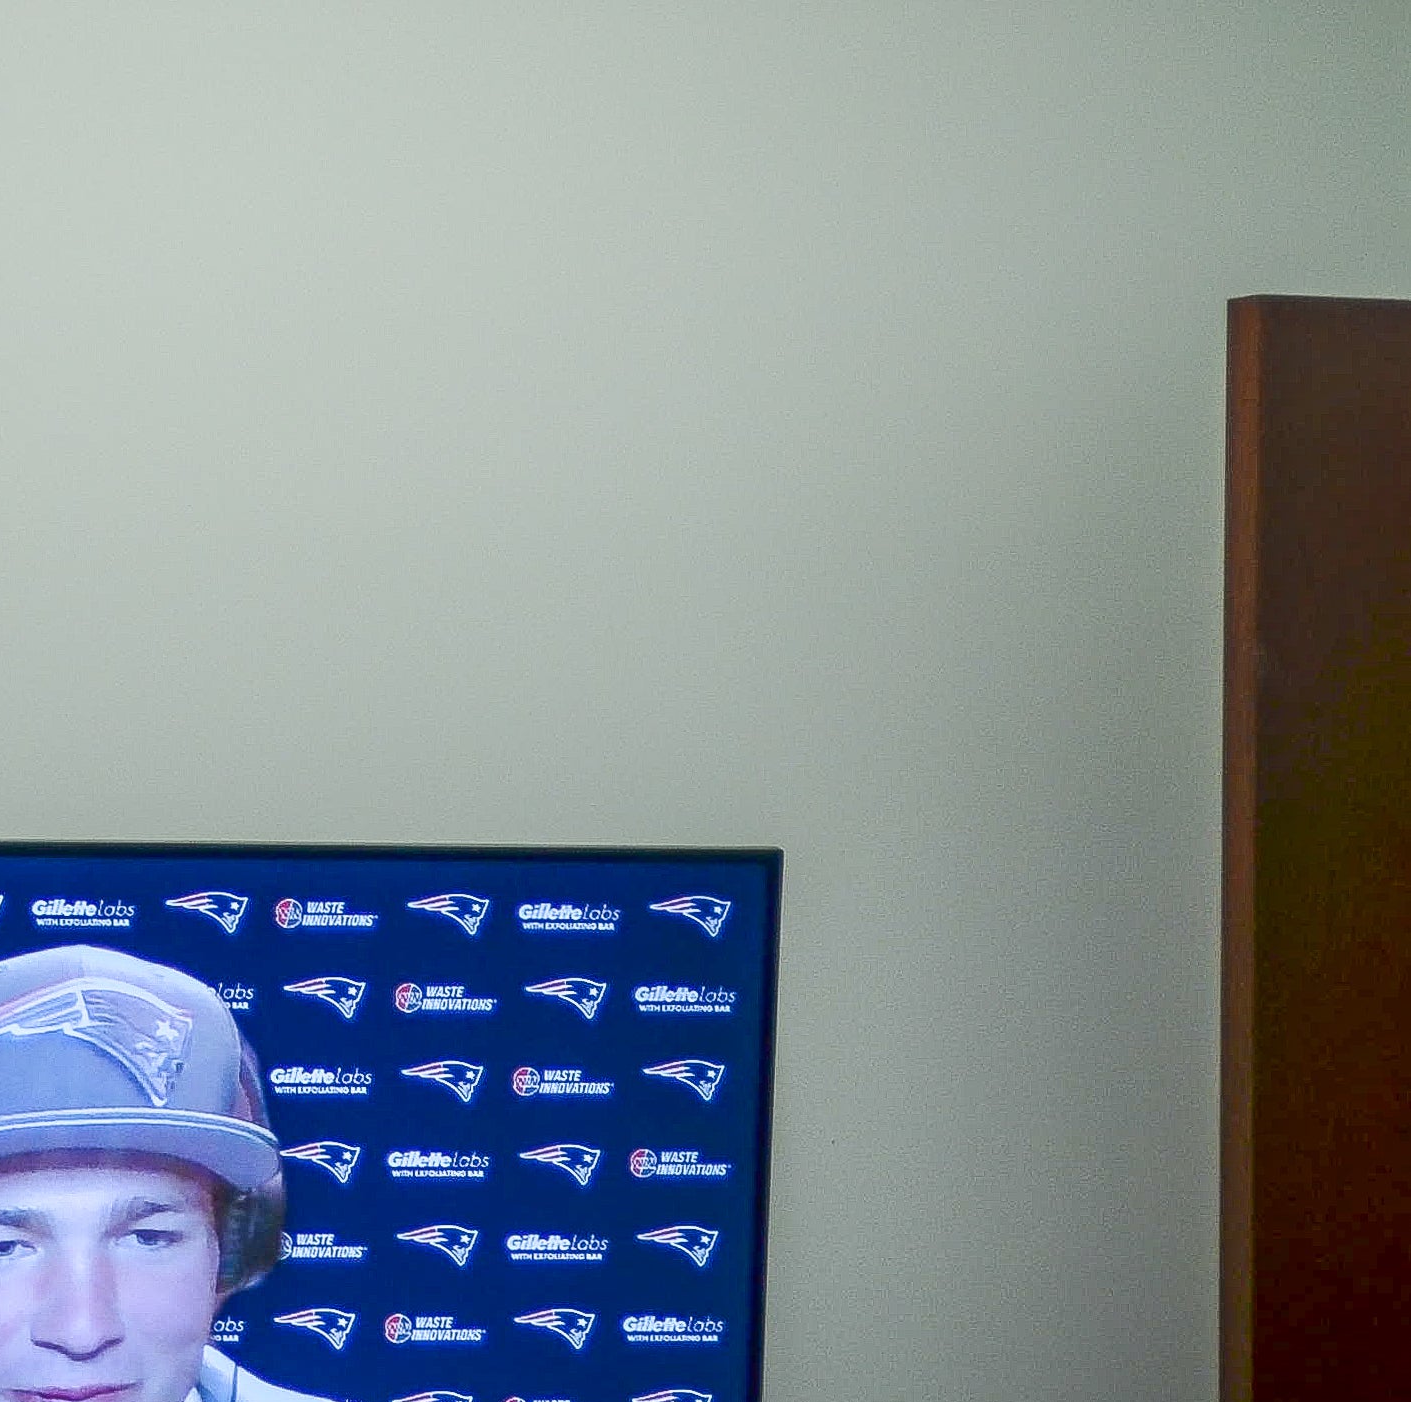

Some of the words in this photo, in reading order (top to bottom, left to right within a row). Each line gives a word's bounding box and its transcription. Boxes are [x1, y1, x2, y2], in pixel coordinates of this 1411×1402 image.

[306, 901, 345, 914] WASTE
[301, 915, 374, 927] INNOVATIONS
[425, 985, 464, 997] WASTE
[421, 998, 493, 1011] INNOVATIONS
[543, 1069, 581, 1081] WASTE
[539, 1082, 610, 1094] INNOVATIONS
[660, 1151, 698, 1163] WASTE
[656, 1164, 727, 1176] INNOVATIONS
[296, 1233, 334, 1245] WASTE
[292, 1246, 363, 1259] INNOVATIONS
[415, 1316, 453, 1328] WASTE
[411, 1329, 482, 1341] INNOVATIONS
